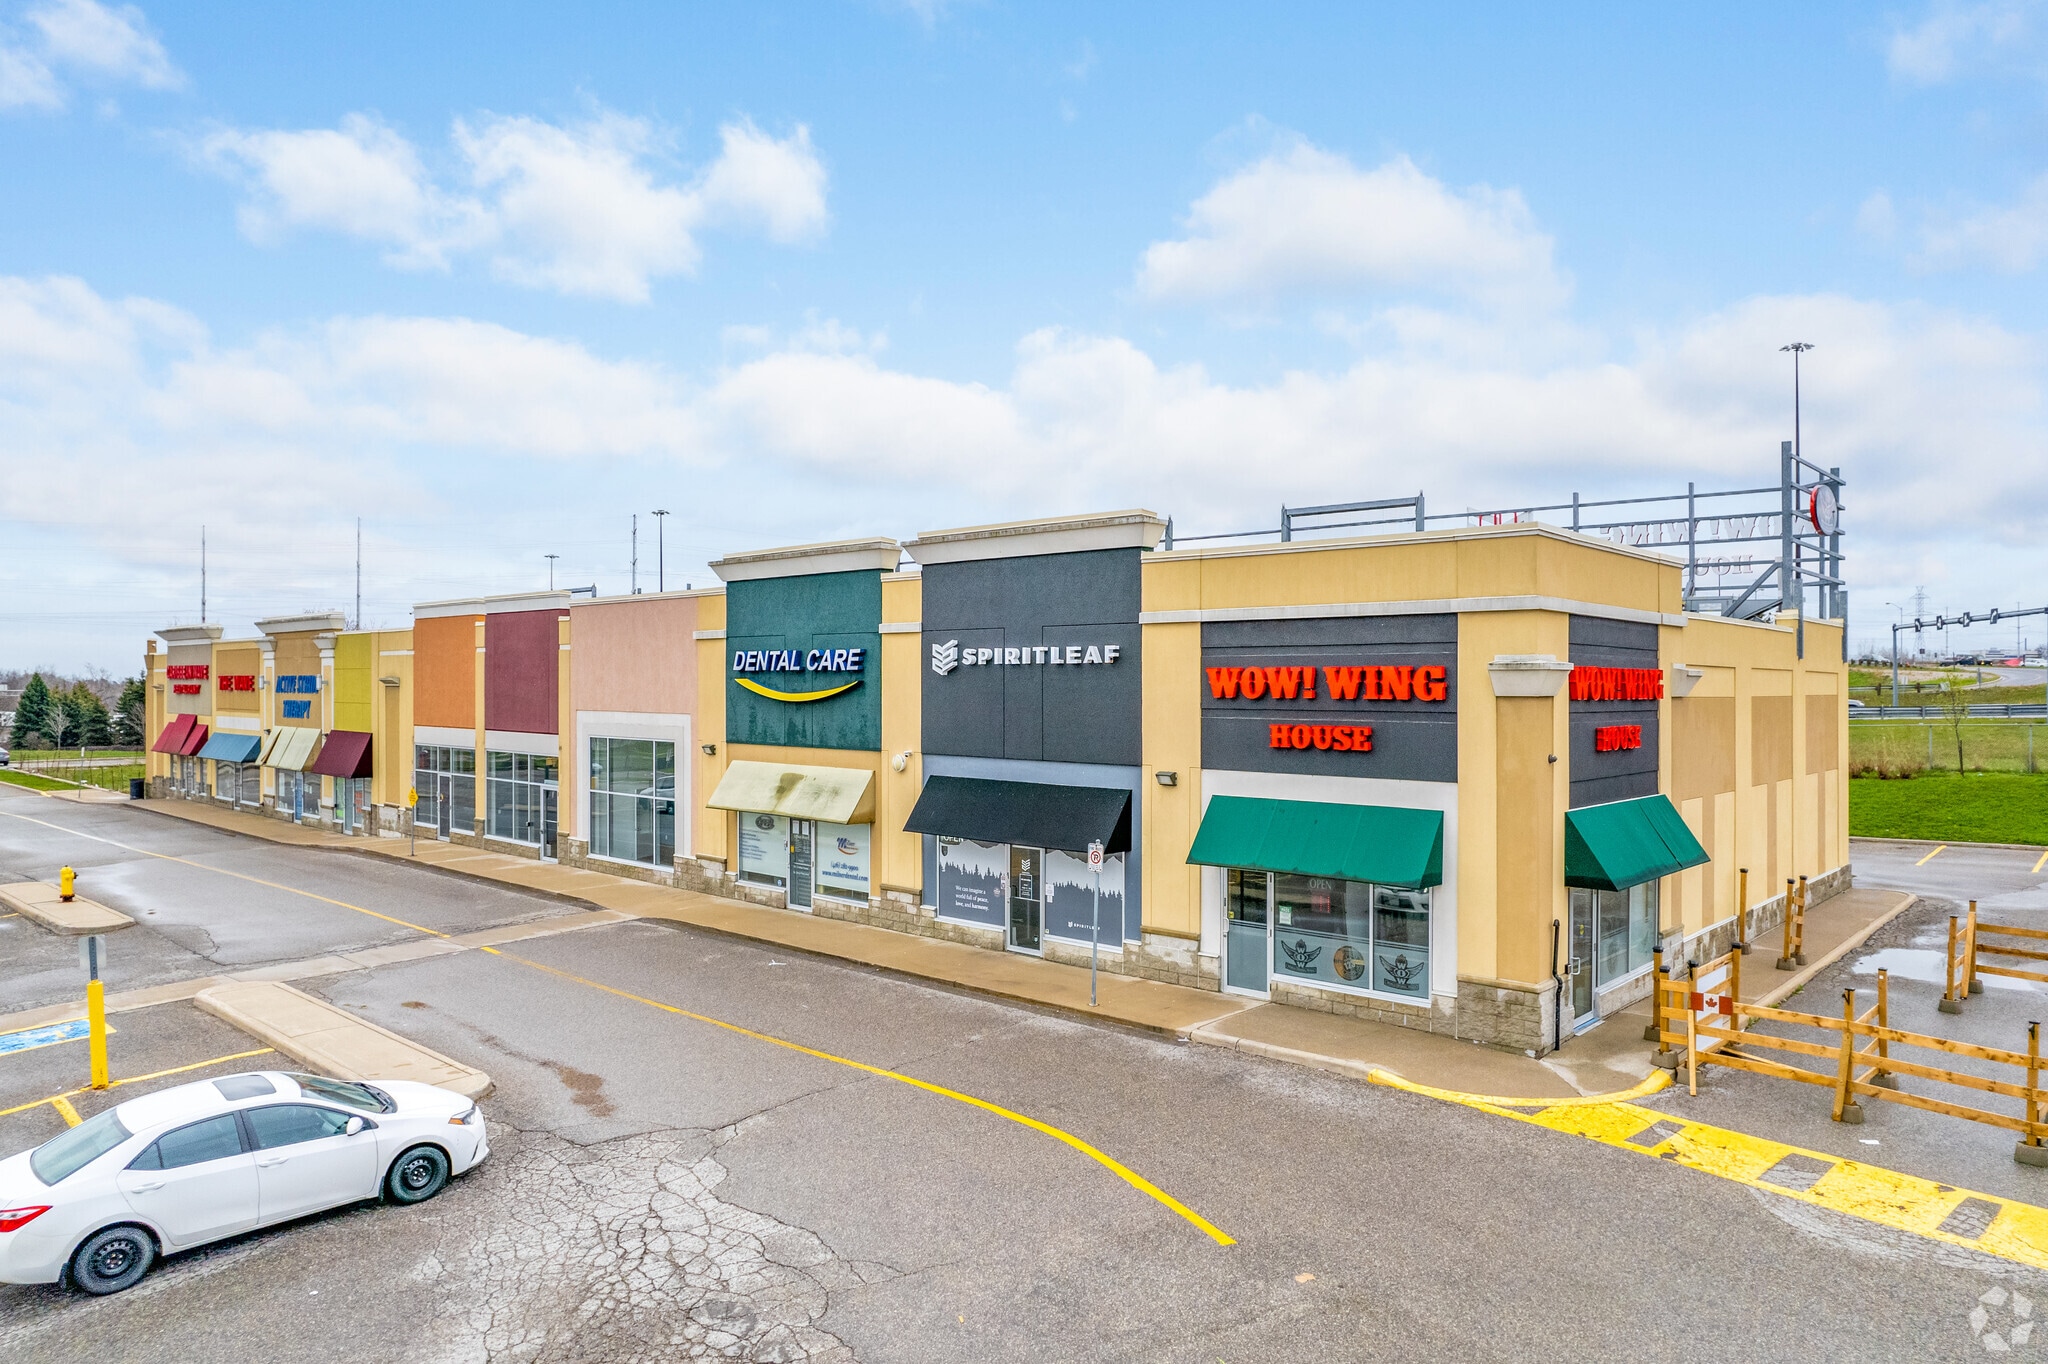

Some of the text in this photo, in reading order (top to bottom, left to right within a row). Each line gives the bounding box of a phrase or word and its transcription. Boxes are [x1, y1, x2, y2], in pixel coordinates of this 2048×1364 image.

[733, 648, 864, 672] DENTAL CARE
[961, 644, 1120, 666] SPIRITLEAF
[1206, 665, 1447, 702] WOW! WING
[1570, 666, 1664, 701] WOW! WING
[1268, 723, 1373, 752] HOUSE
[1596, 725, 1642, 751] HOUSE
[1309, 879, 1332, 891] OPEN
